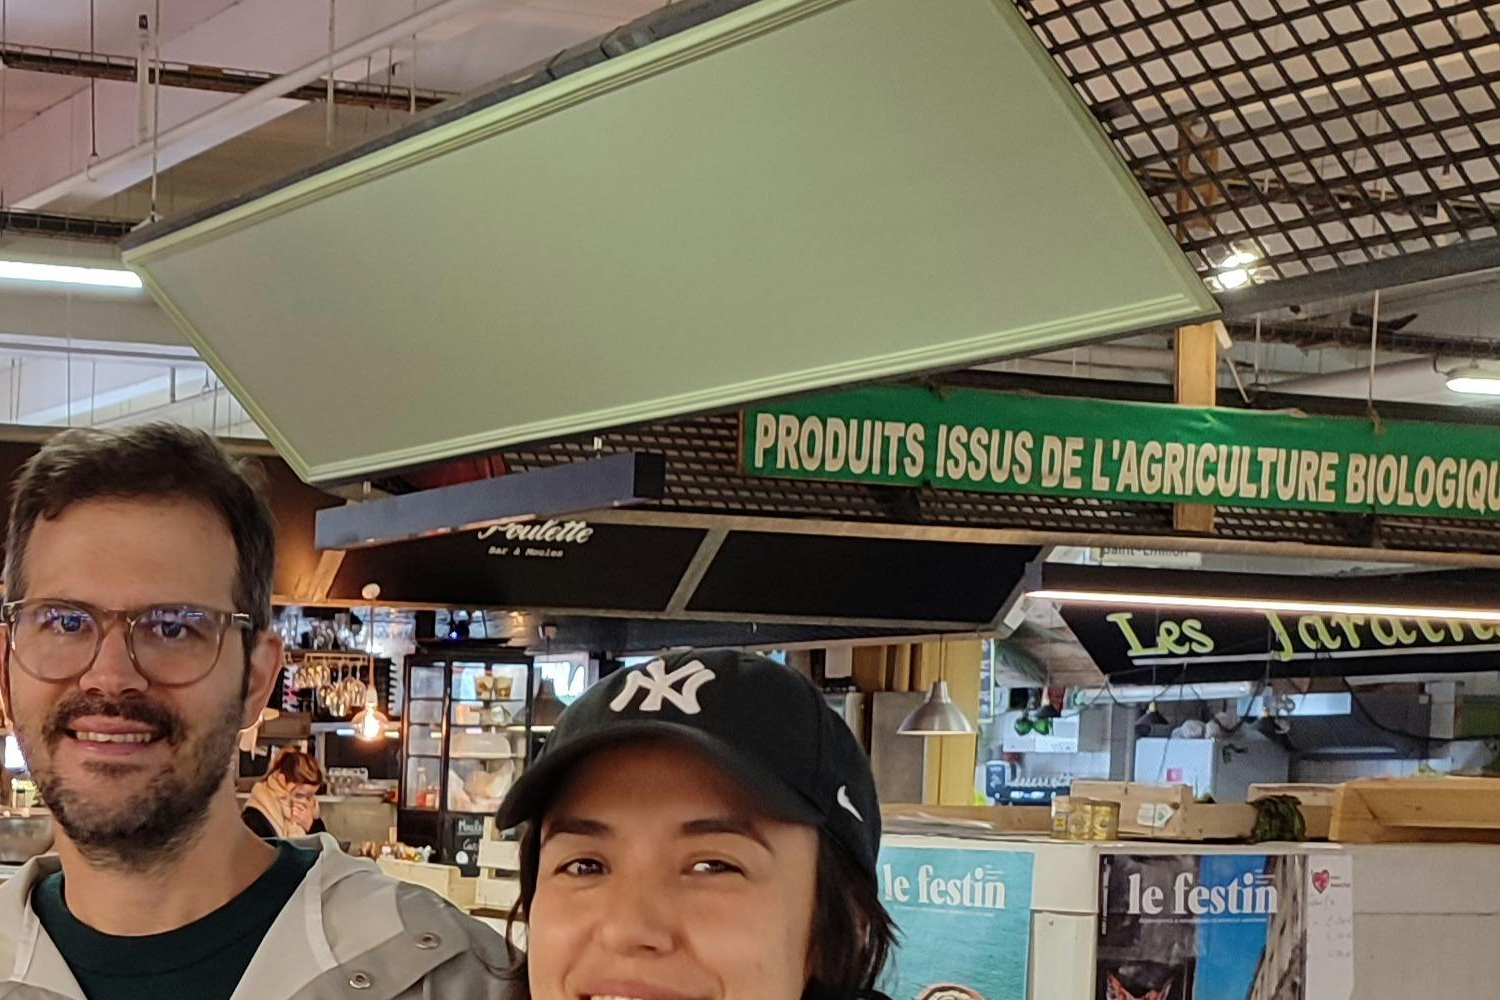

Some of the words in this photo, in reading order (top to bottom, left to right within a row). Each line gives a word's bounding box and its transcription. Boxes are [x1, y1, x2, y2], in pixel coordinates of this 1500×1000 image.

[754, 413, 925, 478] PRODUITS
[935, 424, 1033, 485] ISSUS
[1041, 435, 1084, 490] DE
[1092, 438, 1339, 503] L'AGRICULTURE
[1106, 612, 1215, 657] Les
[883, 863, 911, 903] le
[918, 864, 1006, 910] festin
[1127, 872, 1165, 915] le
[1172, 871, 1279, 915] festin
